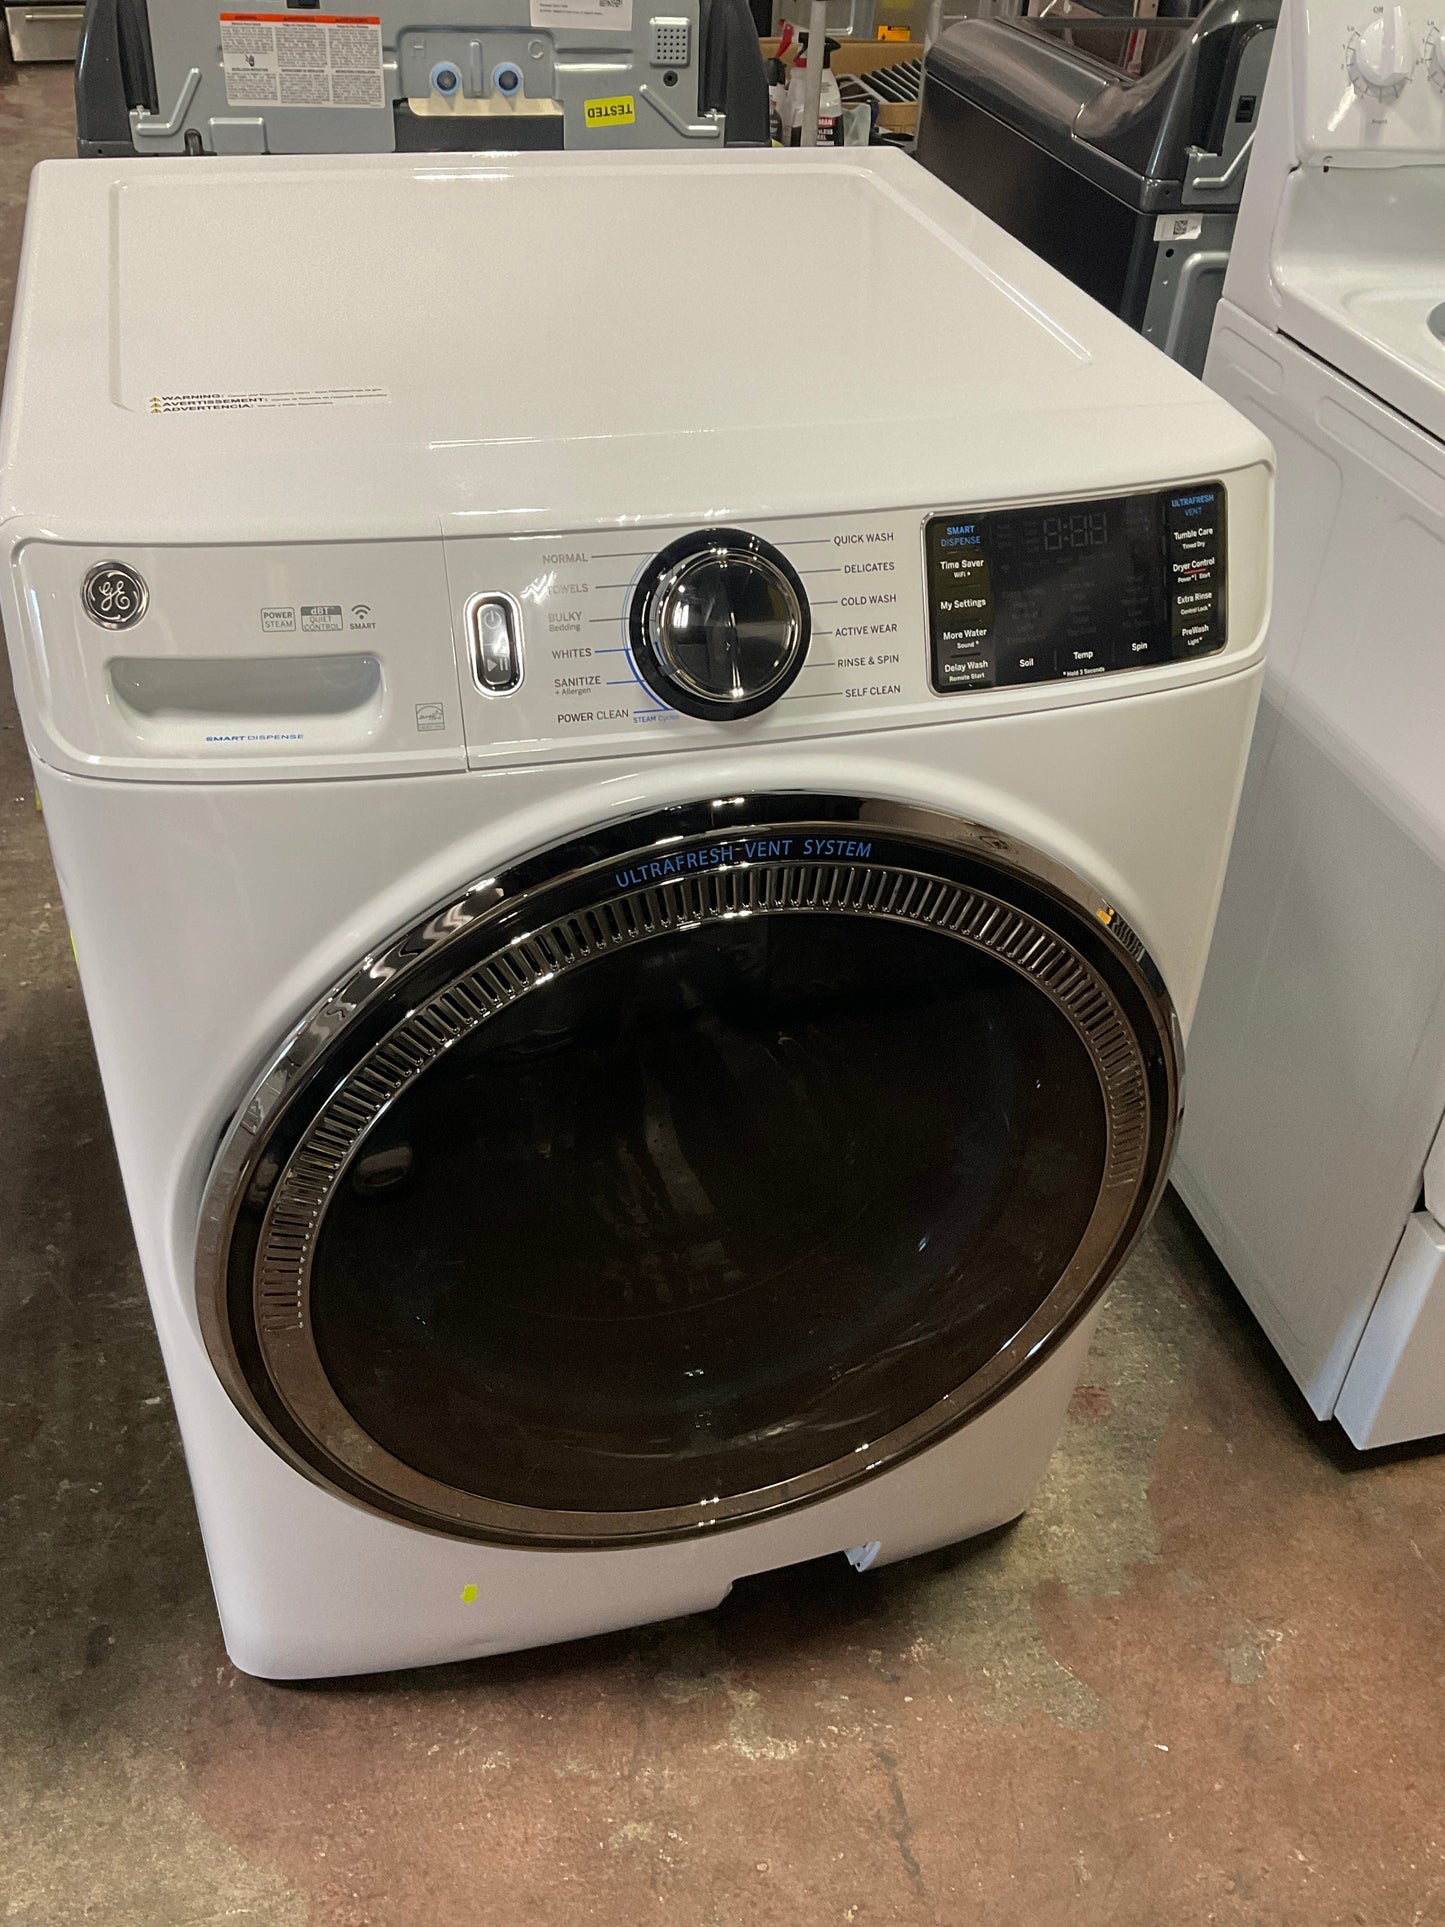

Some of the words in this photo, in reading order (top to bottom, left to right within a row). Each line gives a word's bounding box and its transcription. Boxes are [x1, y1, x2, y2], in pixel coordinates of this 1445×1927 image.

[588, 103, 633, 118] TESTED
[817, 118, 833, 126] MAN
[163, 398, 268, 406] AVERTISSEMENT:
[163, 404, 254, 412] ADVERTENCIA:
[1171, 494, 1214, 507] ULTRAFRESH
[1184, 507, 1202, 516] VENT
[947, 525, 975, 535] SMART
[1174, 530, 1197, 540] Tumble
[1198, 528, 1213, 536] Care
[834, 534, 864, 546] QUICK
[867, 532, 894, 543] WASH
[941, 536, 981, 547] DISPENSE
[543, 553, 588, 564] NORMAL
[844, 562, 895, 573] DELICATES
[940, 561, 960, 570] Time
[962, 560, 984, 568] Saver
[1173, 563, 1190, 573] Dryer
[1192, 557, 1215, 568] Control
[548, 584, 588, 594] TOWELS
[841, 596, 867, 606] COLD
[869, 594, 896, 604] WASH
[1177, 596, 1194, 604] Extra
[1195, 592, 1212, 600] Rinse
[940, 601, 952, 611] My
[954, 599, 986, 608] Settings
[548, 612, 582, 622] BULKY
[265, 620, 293, 628] STEAM
[549, 623, 581, 632] Bedding
[835, 625, 868, 637] ACTIVE
[871, 624, 897, 634] WEAR
[943, 632, 963, 640] More
[964, 629, 987, 638] Water
[1182, 625, 1209, 636] PreWash
[1132, 642, 1148, 652] Spin
[552, 648, 592, 659] WHITES
[1073, 651, 1093, 660] Temp
[838, 657, 866, 668] RINSE
[869, 656, 875, 665] &
[878, 654, 899, 664] SPIN
[945, 664, 966, 672] Delay
[967, 660, 988, 669] Wash
[1020, 658, 1034, 668] Soil
[554, 676, 601, 688] SANITIZE
[562, 687, 591, 696] Allergen
[845, 687, 867, 697] SELF
[870, 684, 900, 695] CLEAN
[558, 712, 593, 723] POWER
[596, 709, 629, 720] CLEAN
[616, 845, 733, 888] ULTRAFRESH
[745, 840, 793, 858] VENT
[803, 840, 872, 858] SYSTEM
